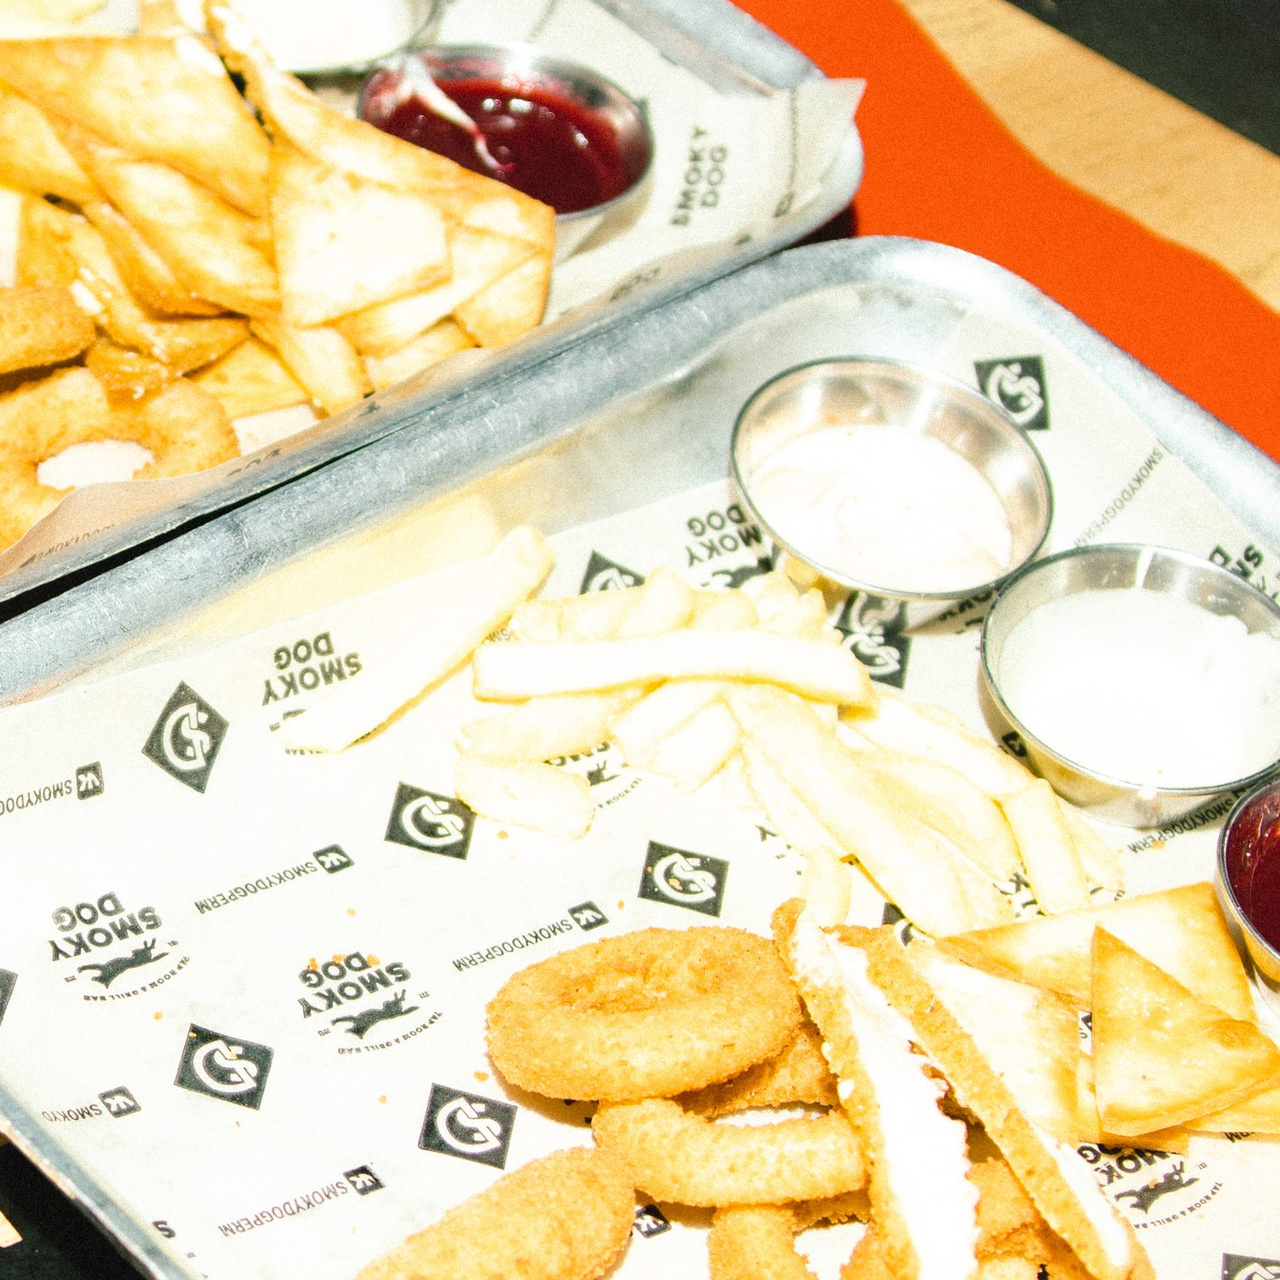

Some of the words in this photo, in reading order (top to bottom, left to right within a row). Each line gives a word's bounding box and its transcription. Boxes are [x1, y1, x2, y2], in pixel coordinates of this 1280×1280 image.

[670, 123, 709, 227] SMOKY
[700, 145, 729, 209] DOG
[685, 524, 763, 568] MOKY
[274, 631, 334, 670] DOG
[262, 652, 363, 706] SMOKY
[51, 891, 125, 932] DOG
[194, 861, 318, 914] SMOKYDOGPERM
[48, 906, 162, 961] SMOKY
[451, 919, 574, 972] SMOKYDOGPERM
[297, 962, 412, 1018] SMOKY
[298, 951, 372, 989] DOG
[218, 1180, 349, 1237] SMOKYDOGPERM
